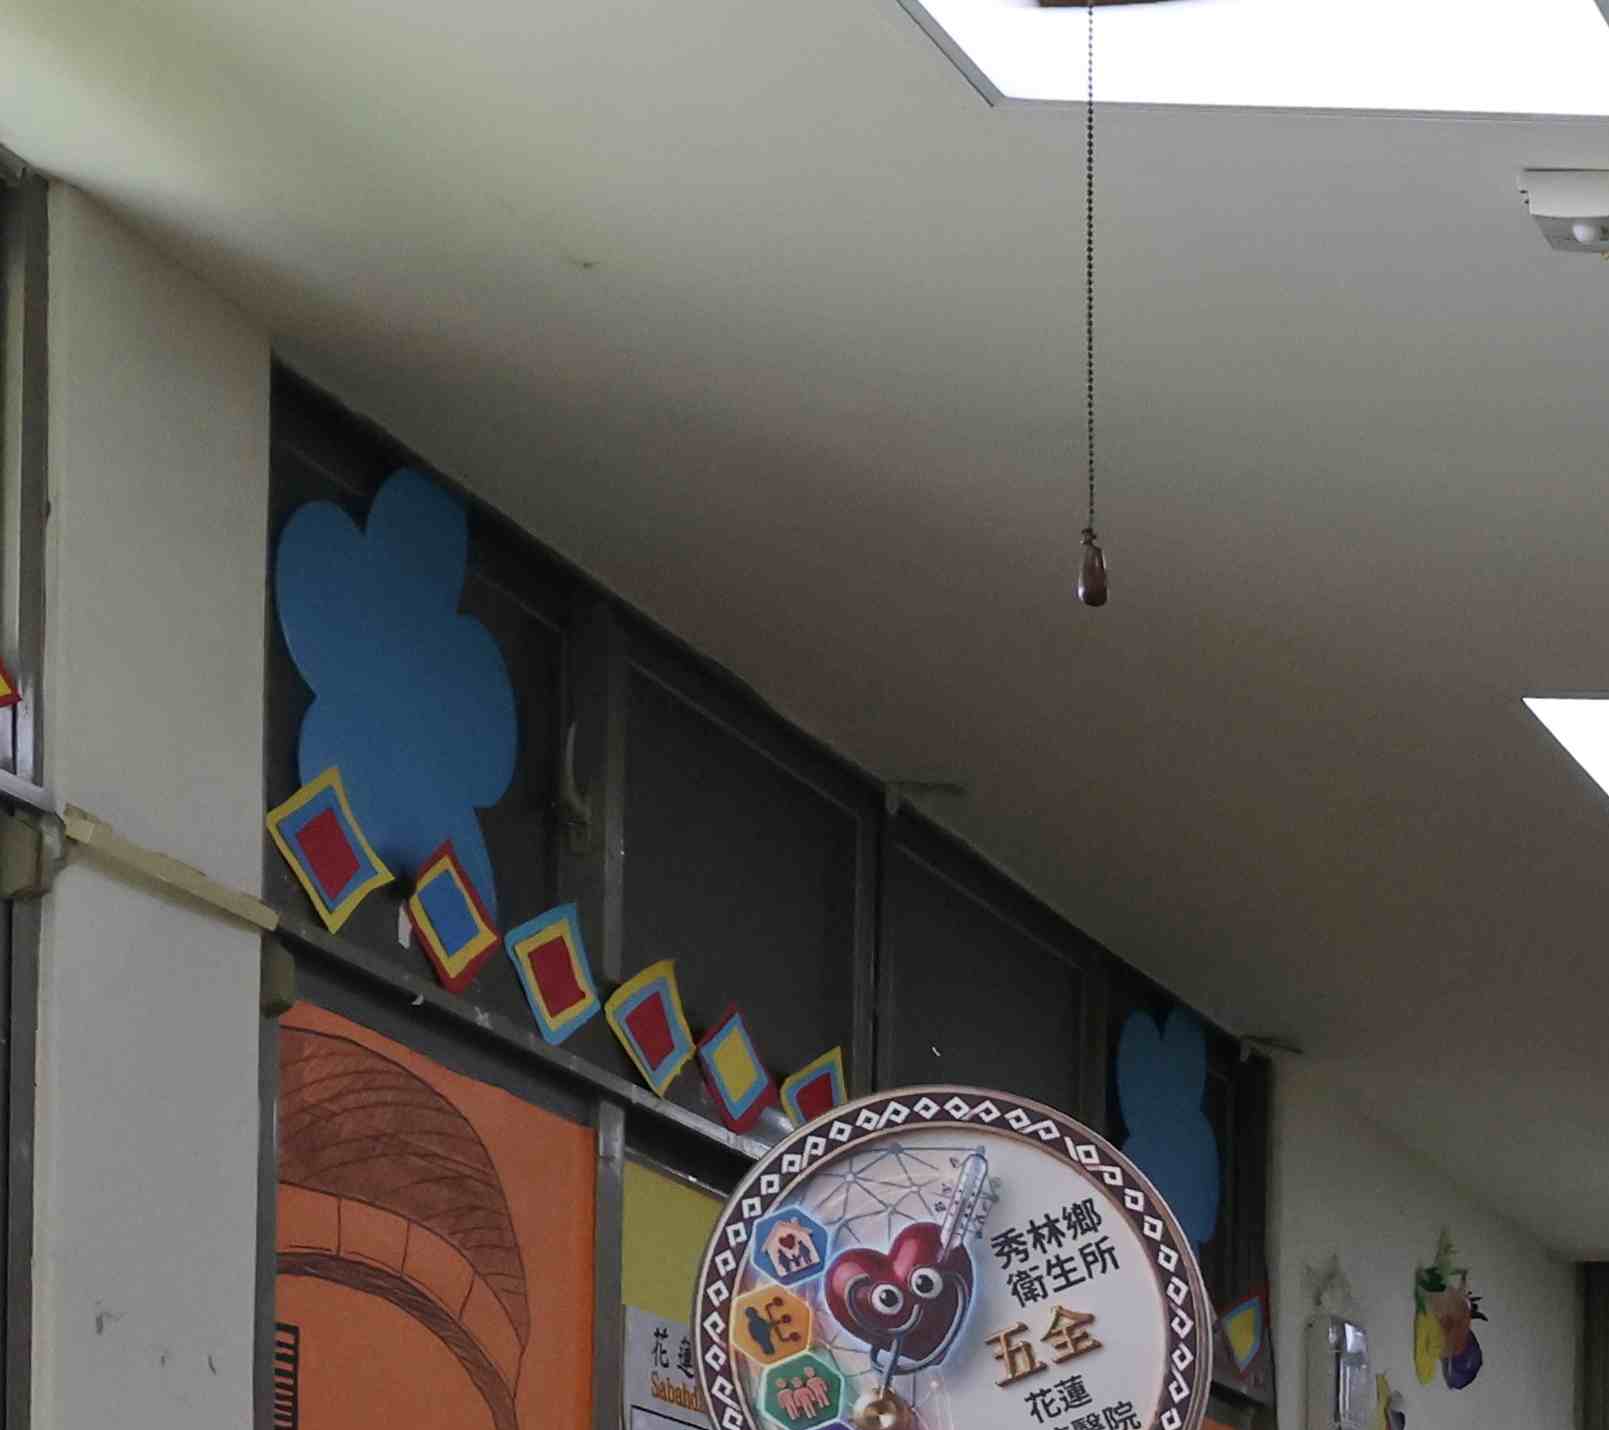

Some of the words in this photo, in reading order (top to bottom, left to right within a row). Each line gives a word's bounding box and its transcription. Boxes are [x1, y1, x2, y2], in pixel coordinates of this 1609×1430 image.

[991, 1198, 1104, 1271] 秀林鄉
[1005, 1237, 1120, 1309] 衛生所
[985, 1304, 1104, 1388] 五全
[1024, 1377, 1093, 1424] 花蓮
